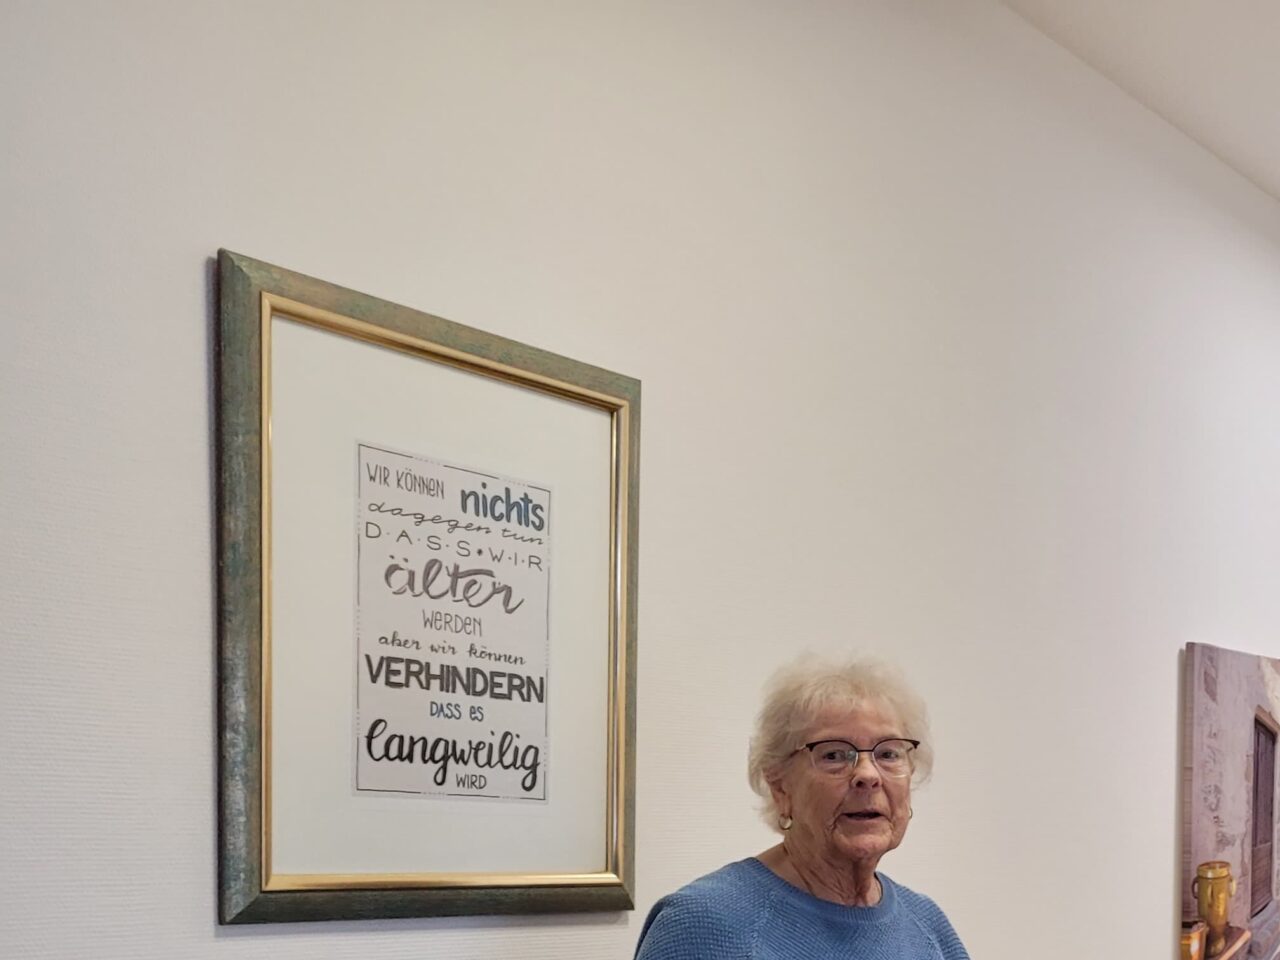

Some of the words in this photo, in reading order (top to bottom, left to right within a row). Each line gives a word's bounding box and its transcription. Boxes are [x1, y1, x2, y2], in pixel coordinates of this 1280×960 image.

[366, 462, 390, 487] WIR
[368, 501, 492, 534] dagegen
[501, 528, 544, 545] tun
[460, 481, 545, 531] nichts
[384, 554, 525, 614] älter
[378, 631, 422, 650] aber
[430, 641, 457, 655] wir
[467, 643, 526, 666] können
[364, 653, 545, 704] VERHINDERN
[429, 701, 462, 720] DASS
[364, 718, 541, 792] langweilig
[455, 773, 488, 790] WIRD
